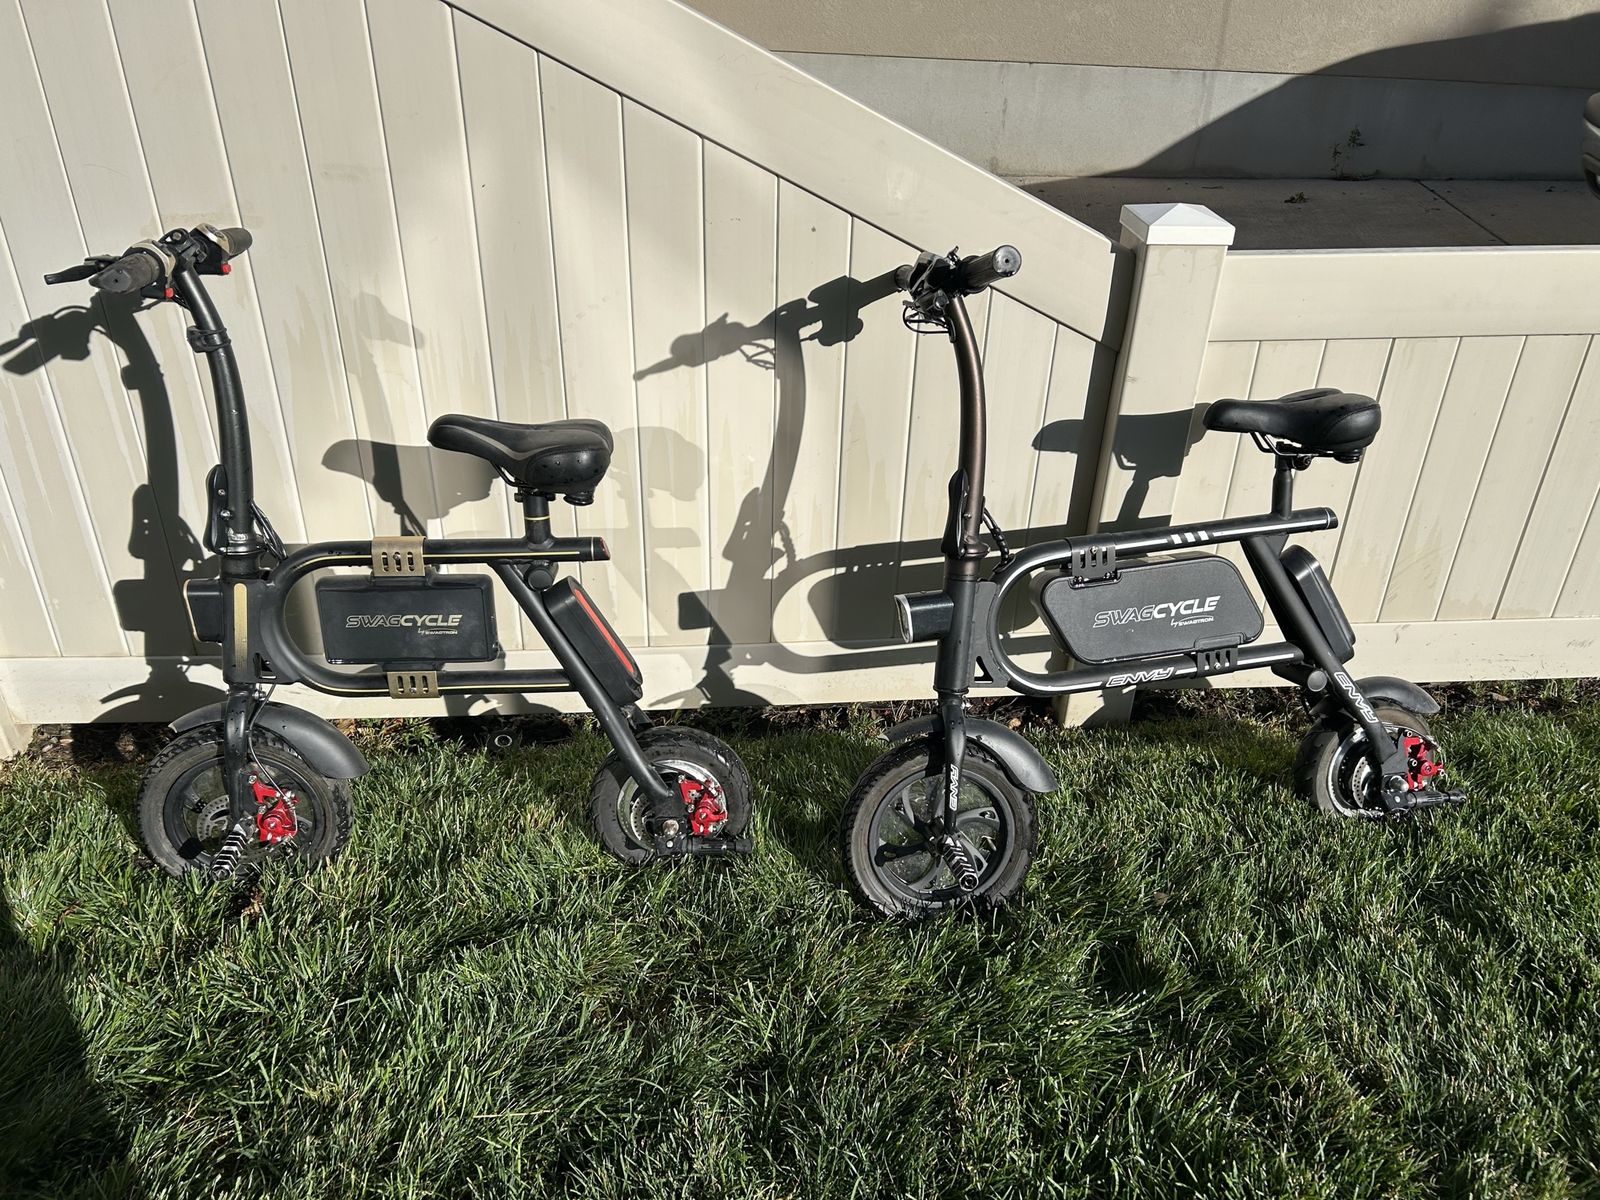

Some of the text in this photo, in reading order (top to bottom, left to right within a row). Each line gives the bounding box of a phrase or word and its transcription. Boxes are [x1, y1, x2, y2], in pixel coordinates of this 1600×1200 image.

[345, 614, 463, 628] SWAGCYCLE
[1093, 595, 1221, 628] SWAGCYCLE
[1106, 667, 1175, 687] ENVY
[1333, 671, 1379, 723] ENVY
